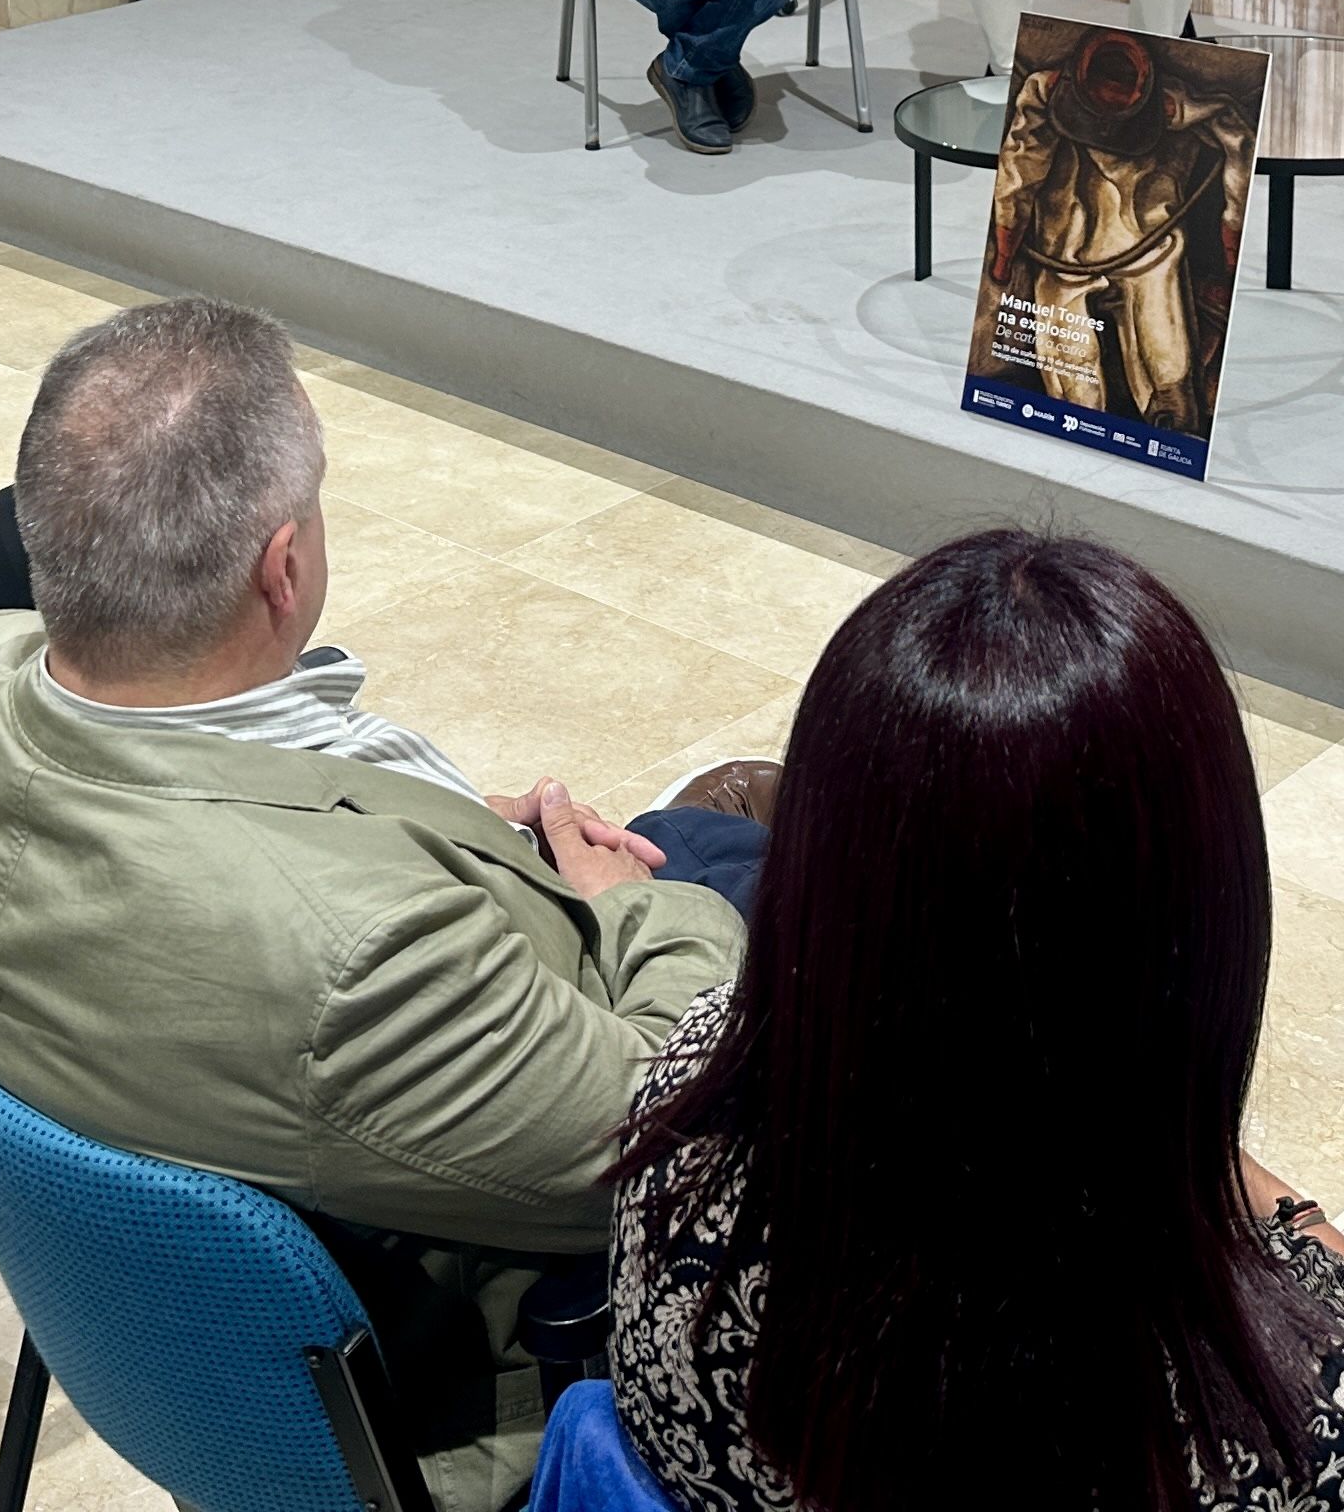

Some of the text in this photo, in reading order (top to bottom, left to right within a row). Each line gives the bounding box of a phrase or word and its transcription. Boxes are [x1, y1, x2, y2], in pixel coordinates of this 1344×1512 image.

[997, 311, 1090, 345] na explosión
[1000, 292, 1105, 332] Manuel Torres
[996, 324, 1012, 338] De
